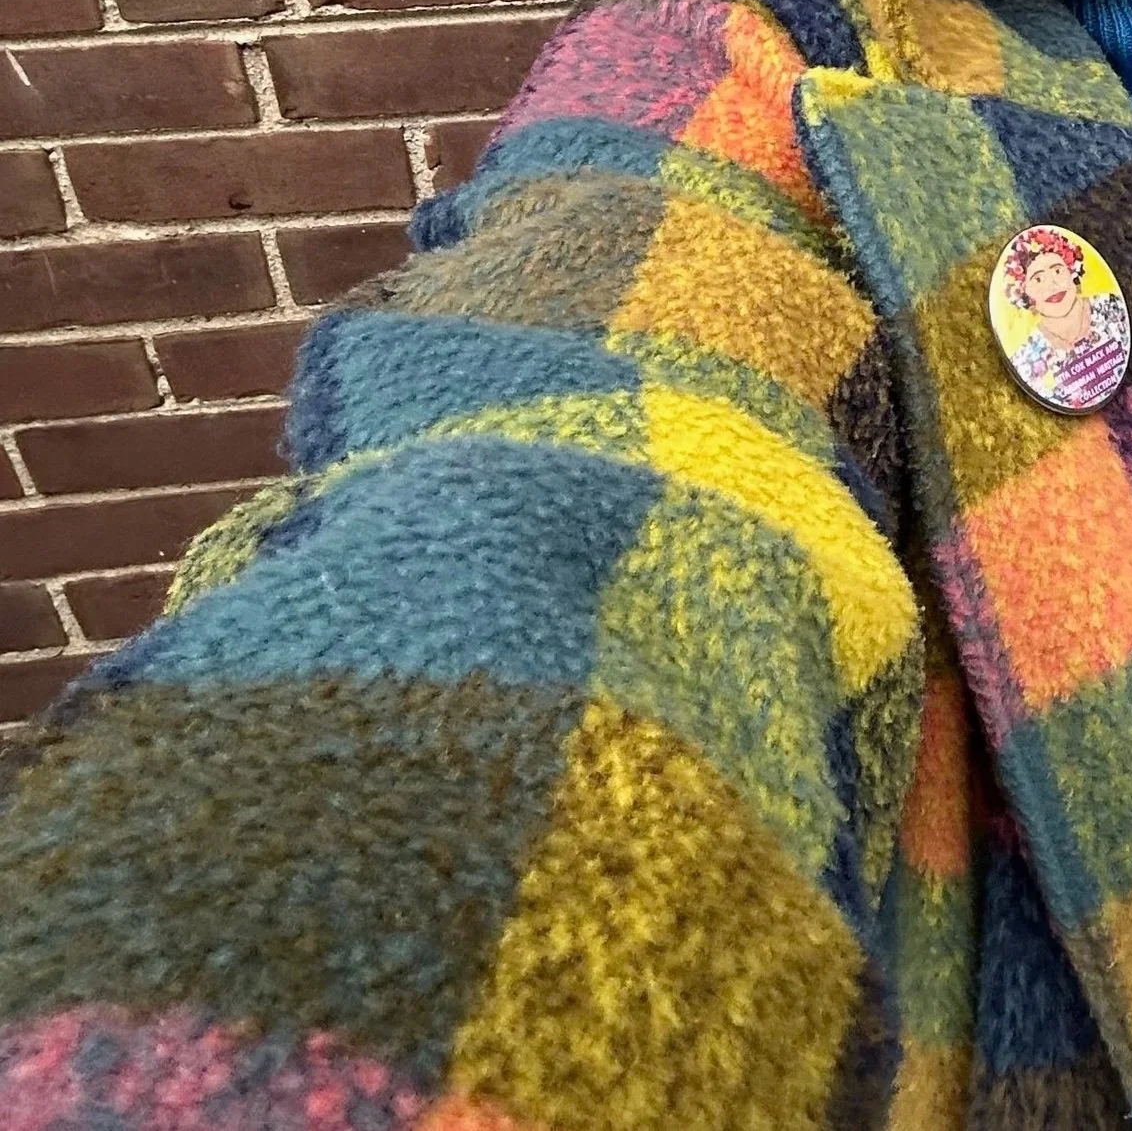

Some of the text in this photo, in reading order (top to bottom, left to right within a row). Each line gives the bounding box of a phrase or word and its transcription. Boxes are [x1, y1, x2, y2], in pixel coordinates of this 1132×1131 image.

[1071, 361, 1086, 375] COX
[1085, 349, 1105, 367] BLACK
[1105, 341, 1119, 354] AND
[1097, 353, 1124, 375] HERITAGE
[1081, 375, 1116, 403] COLLECTION
